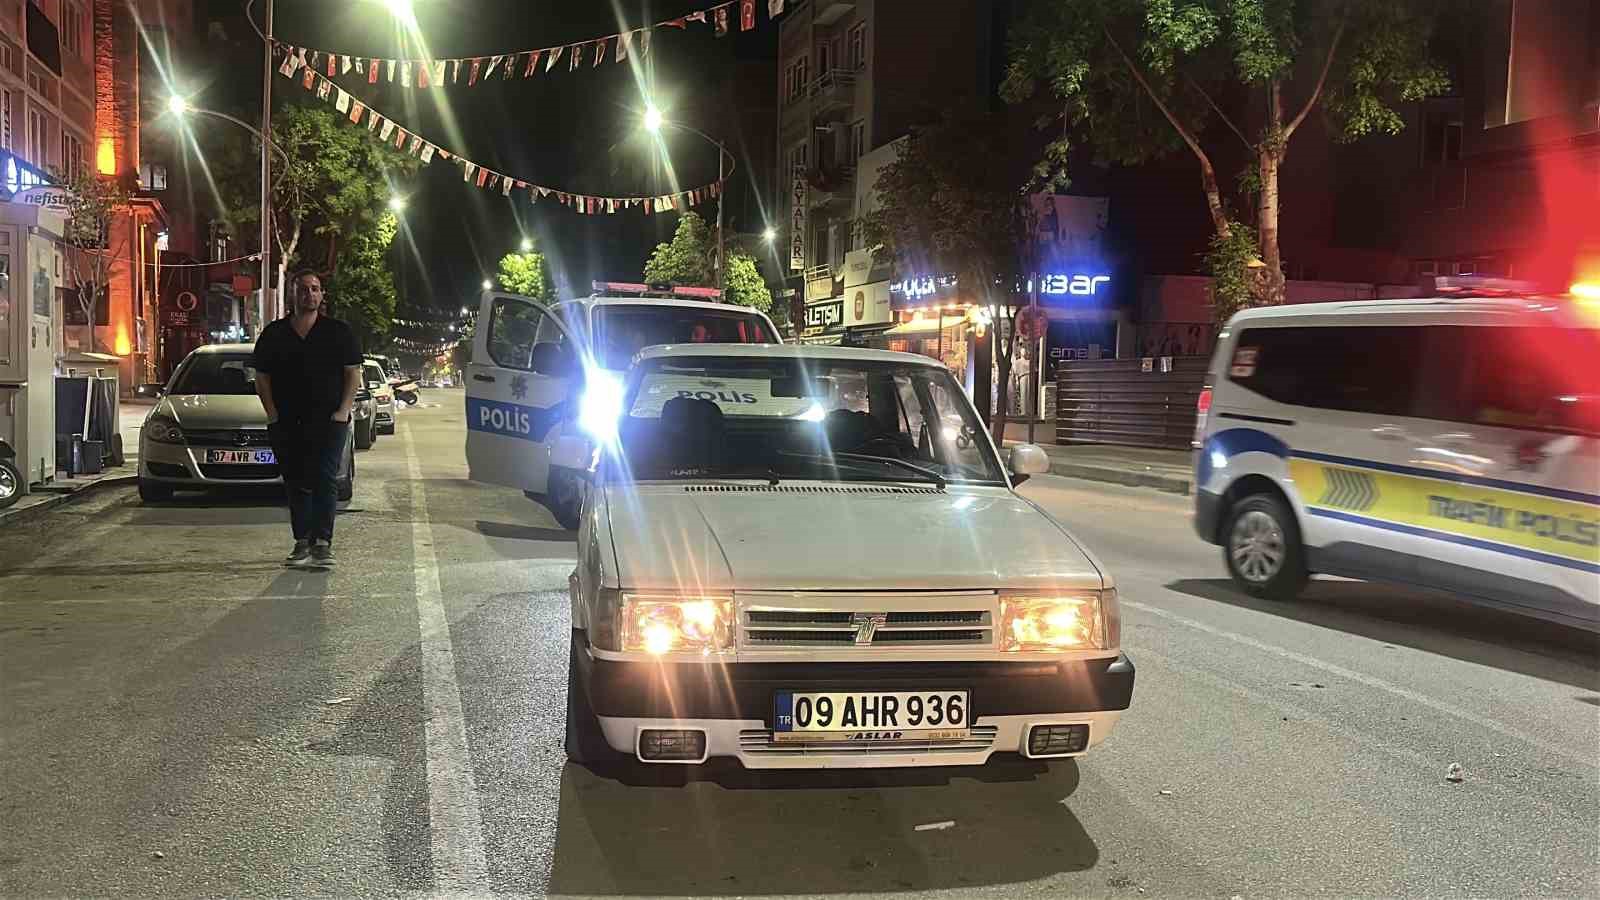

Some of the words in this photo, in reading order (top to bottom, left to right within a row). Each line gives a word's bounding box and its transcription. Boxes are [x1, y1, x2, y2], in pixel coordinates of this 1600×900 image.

[674, 390, 758, 404] POLİS
[480, 406, 530, 434] POLİS
[214, 451, 225, 462] 07
[254, 452, 272, 462] 457
[1515, 509, 1600, 547] POLİS
[779, 715, 791, 725] TR
[795, 695, 833, 728] 09
[841, 695, 899, 727] AHR
[906, 694, 964, 726] 936
